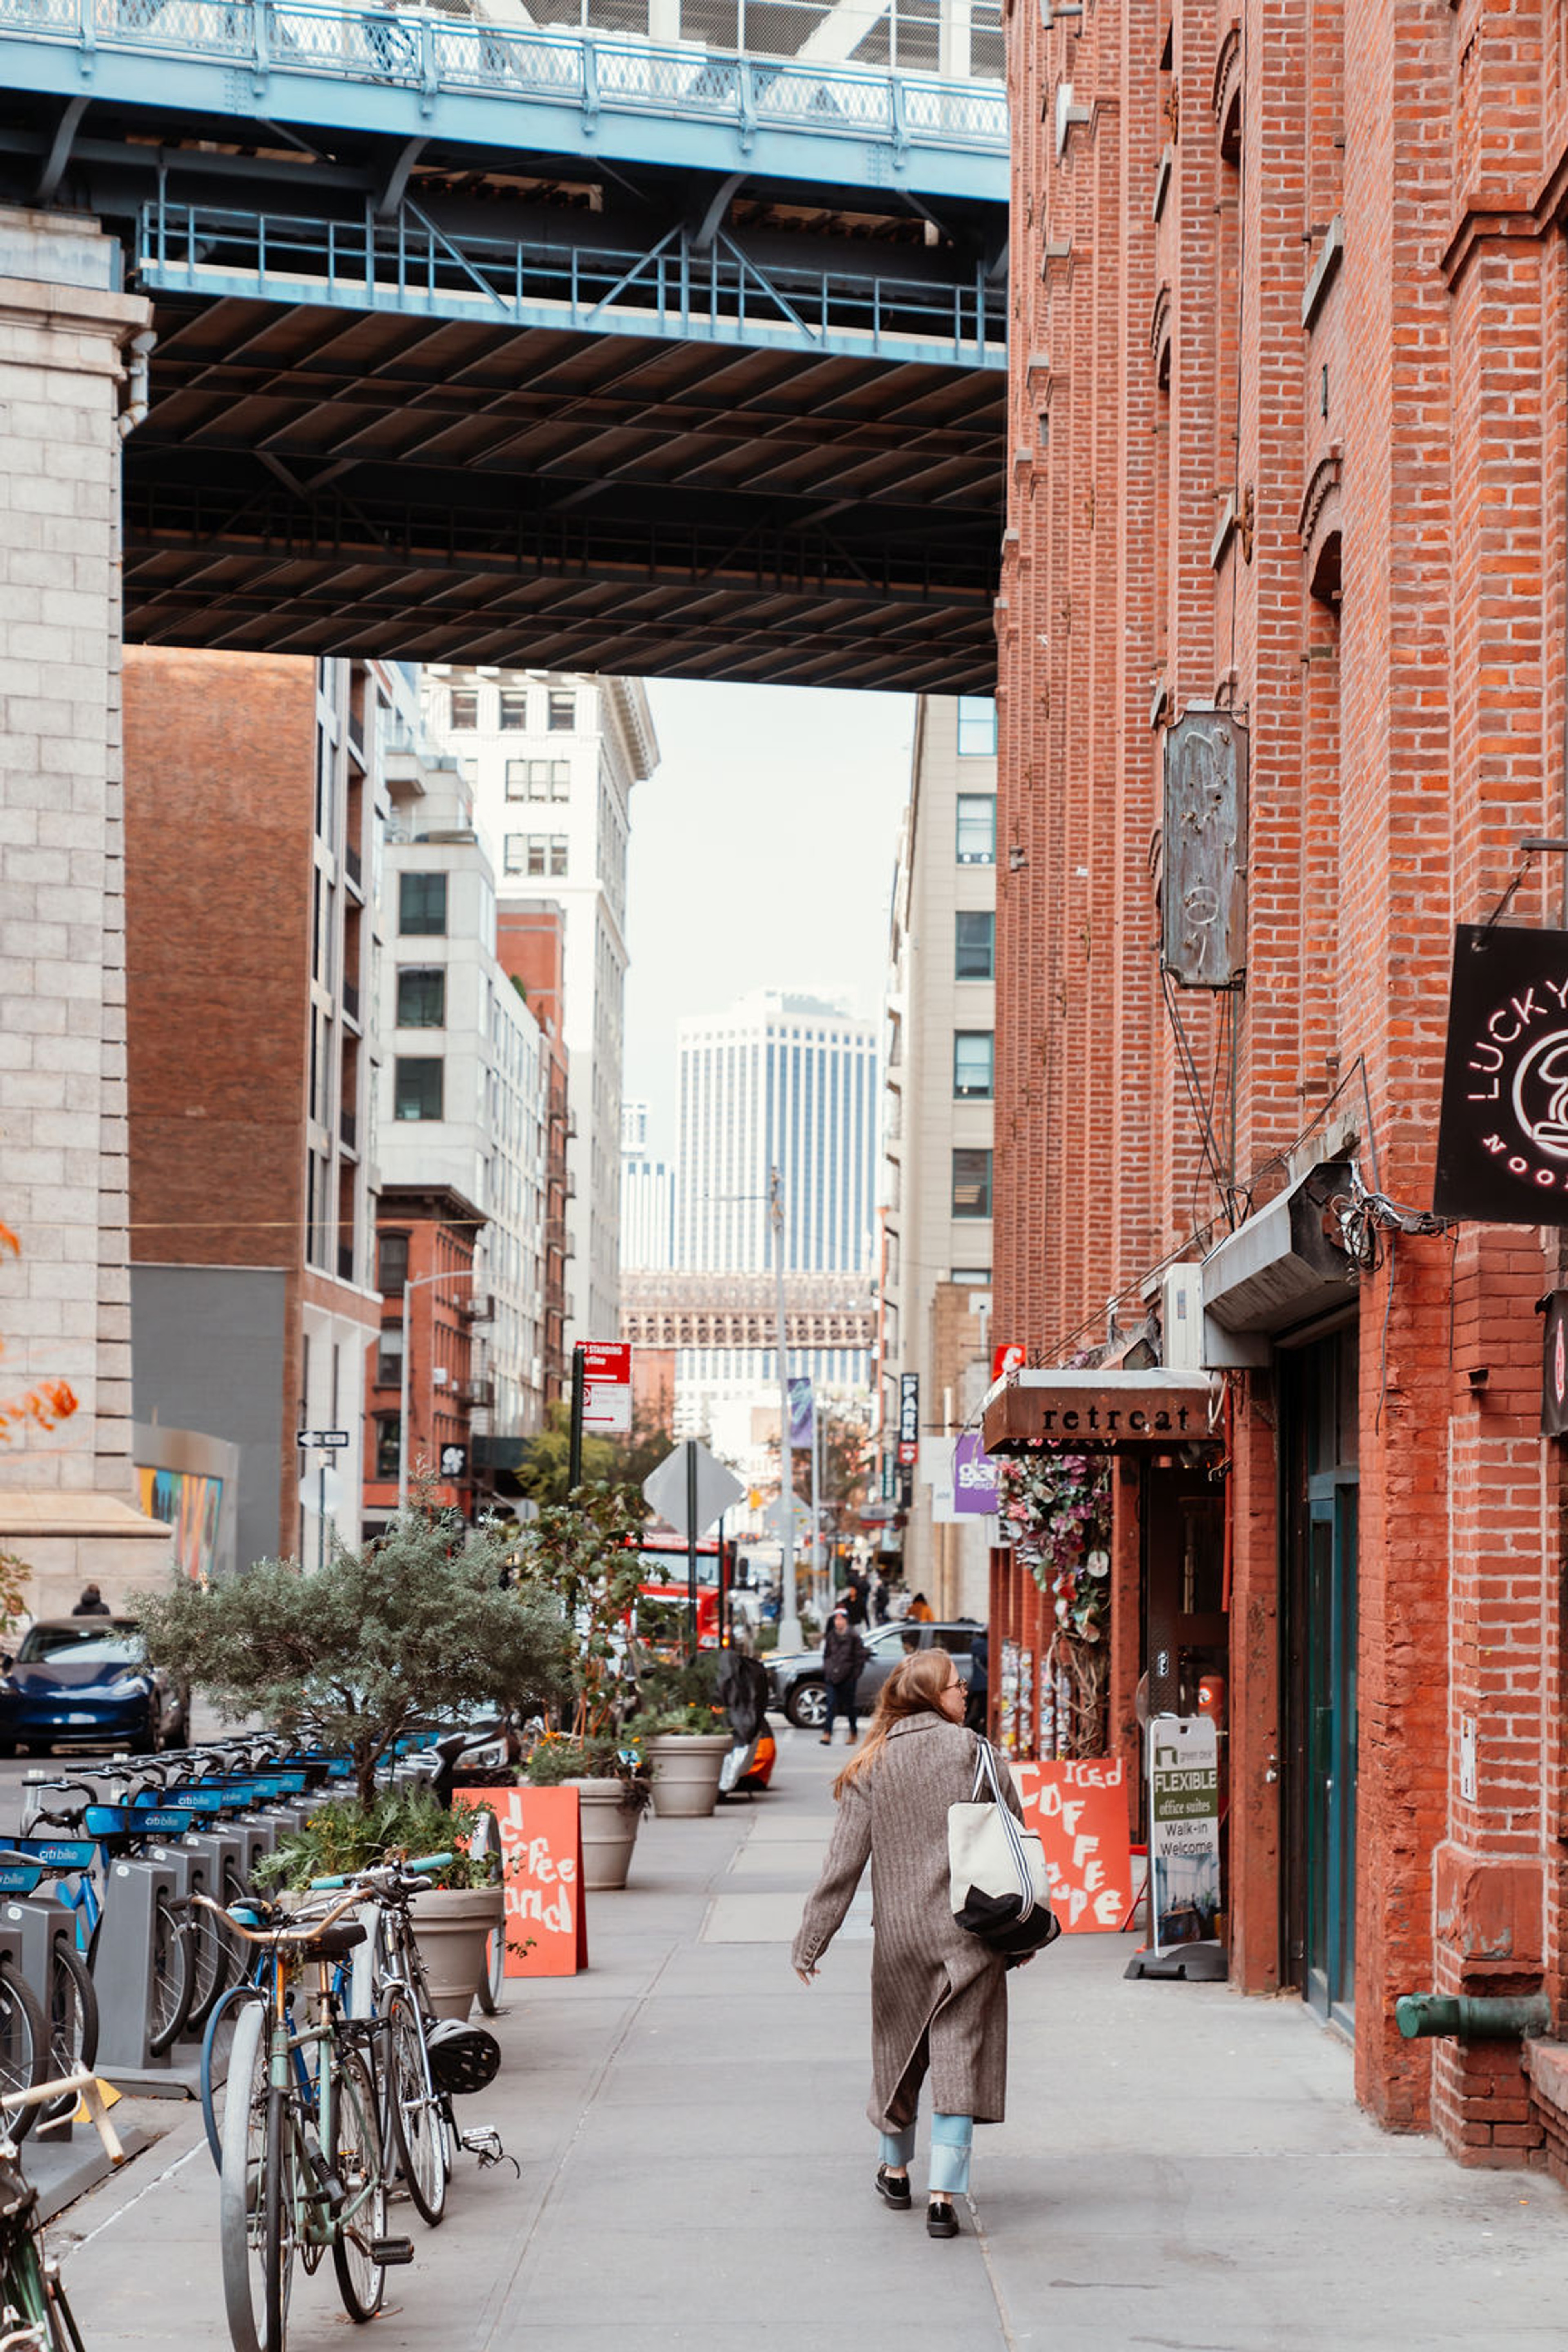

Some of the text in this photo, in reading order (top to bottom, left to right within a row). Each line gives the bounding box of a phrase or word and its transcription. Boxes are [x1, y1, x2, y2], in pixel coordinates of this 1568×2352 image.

[1468, 978, 1568, 1099] LUCKY
[1483, 1134, 1568, 1189] NOO
[903, 1383, 917, 1441] PARK
[1155, 1770, 1216, 1793] FLEXIBLE
[1159, 1798, 1211, 1815] office suites
[1165, 1822, 1207, 1836] Walk-in
[1160, 1840, 1213, 1855] Welcome
[504, 1884, 574, 1933] and
